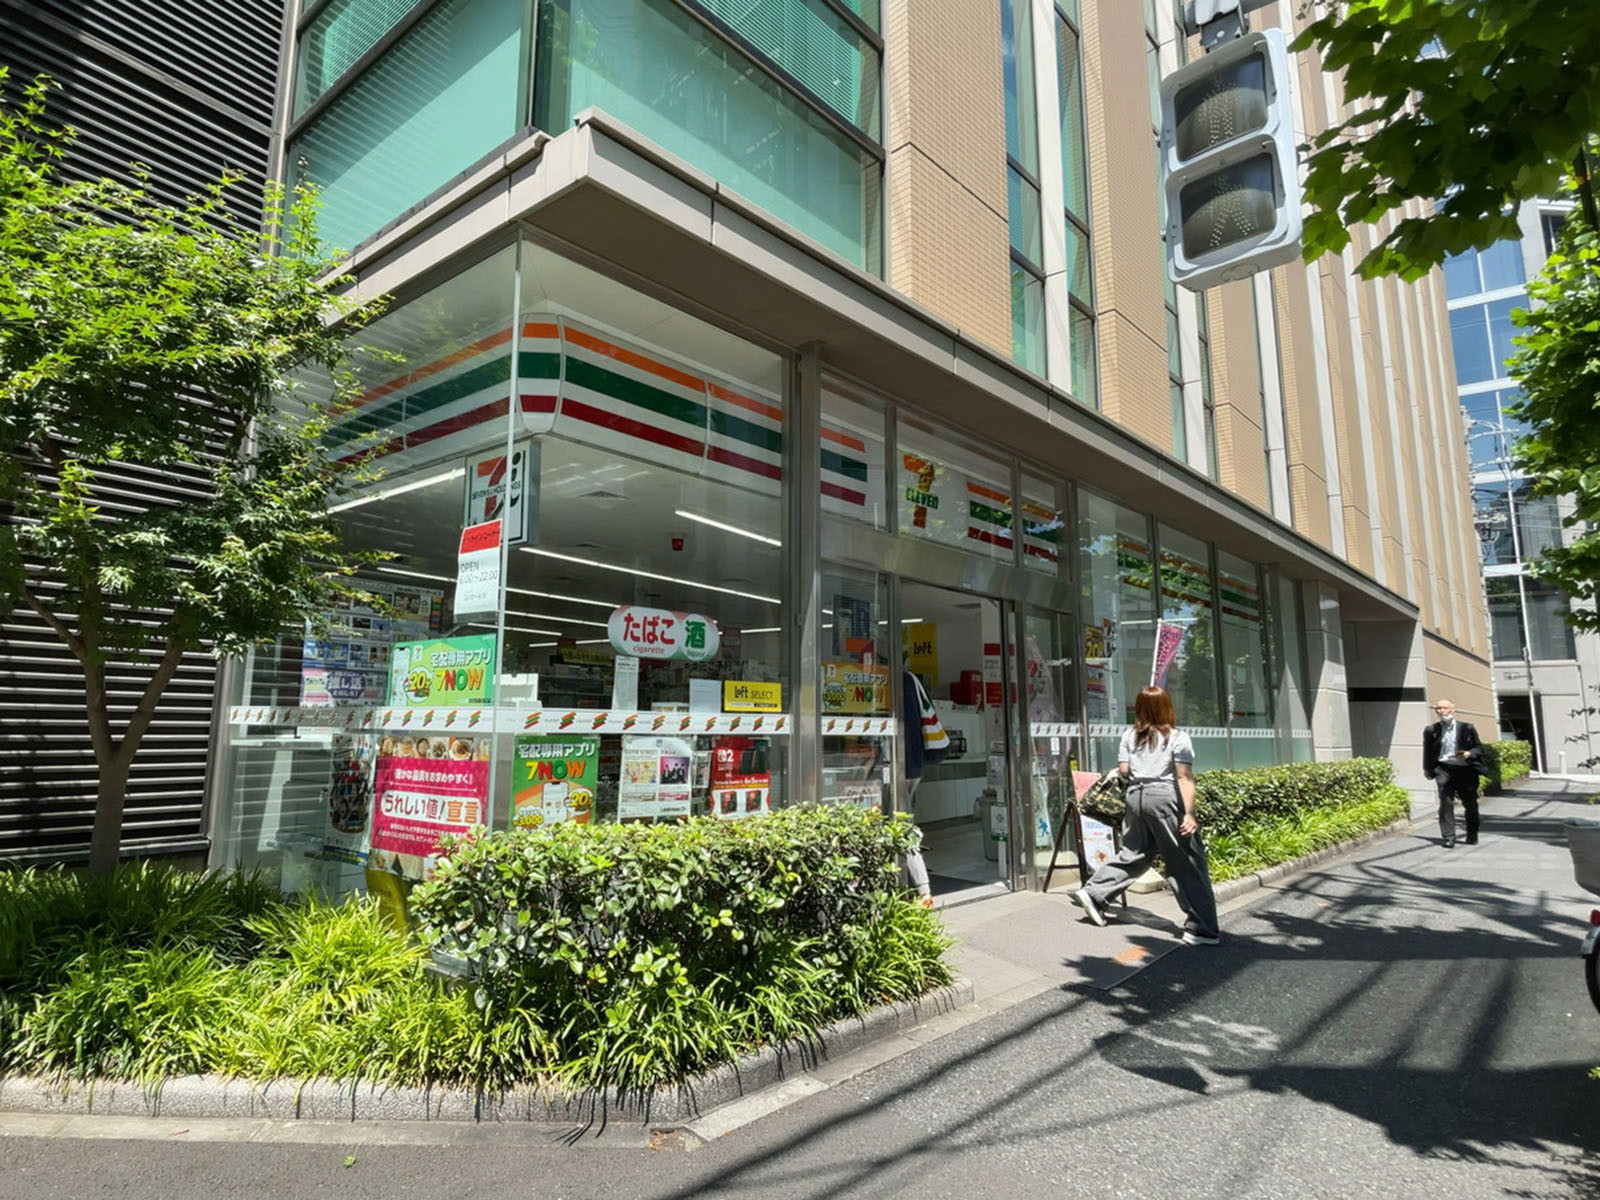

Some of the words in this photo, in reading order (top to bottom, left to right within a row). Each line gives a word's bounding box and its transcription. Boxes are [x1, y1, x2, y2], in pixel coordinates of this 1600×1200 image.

[460, 560, 480, 574] OPEN
[623, 612, 675, 645] たばこ
[684, 620, 706, 649] 酒
[431, 648, 492, 667] 宅配専用アプリ
[632, 645, 665, 655] cigarette
[436, 668, 484, 691] 7NOW
[750, 690, 774, 699] SELECT
[518, 742, 596, 758] 宅配専用アプリ
[525, 760, 586, 780] 7NOW
